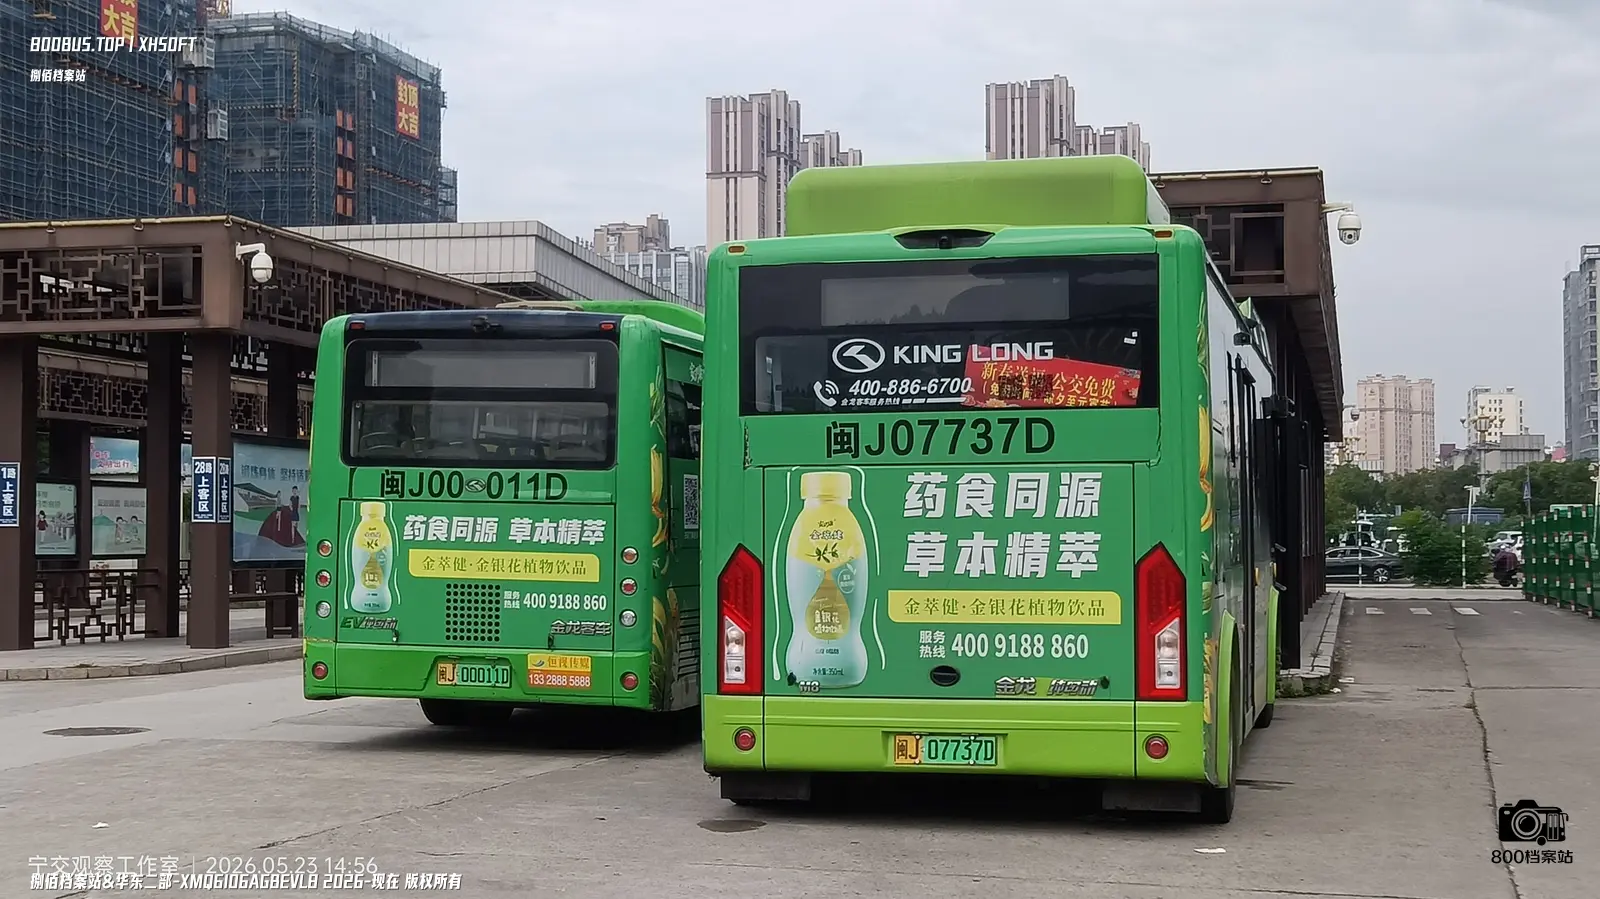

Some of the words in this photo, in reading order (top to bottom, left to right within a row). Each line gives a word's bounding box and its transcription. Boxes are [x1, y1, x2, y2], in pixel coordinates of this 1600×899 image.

[103, 4, 136, 40] 大吉
[397, 79, 418, 109] 封顶
[398, 107, 418, 137] 大吉
[893, 344, 962, 365] KING
[972, 341, 1054, 362] LONG
[849, 377, 972, 396] 400-886-6700
[1052, 371, 1116, 399] 公交免费
[840, 397, 900, 407] 金龙客车服务热线
[825, 417, 1056, 459] 闽J07737D
[1, 467, 16, 479] 1路
[194, 461, 213, 474] 28路
[2, 481, 15, 517] 上客区
[197, 475, 210, 512] 上客区
[902, 471, 1103, 518] 药食同源
[402, 515, 499, 542] 药食同源
[508, 517, 607, 546] 草本精萃
[902, 531, 1102, 578] 草本精萃
[422, 555, 587, 576] 金萃健·金银花植物饮品
[504, 590, 520, 600] 服务
[504, 600, 520, 609] 热线
[523, 592, 547, 608] 400
[549, 593, 580, 610] 9188
[583, 595, 607, 611] 860
[904, 597, 1106, 617] 金萃健·金银花植物饮品
[551, 620, 613, 637] 金龙客车
[919, 630, 945, 644] 服务
[919, 645, 945, 659] 热线
[951, 633, 989, 657] 400
[994, 633, 1045, 658] 9188
[1051, 634, 1089, 659] 860
[529, 673, 545, 685] 133
[546, 674, 568, 686] 2888
[568, 675, 590, 687] 5888
[995, 676, 1037, 696] 金龙
[927, 739, 995, 761] 07737D
